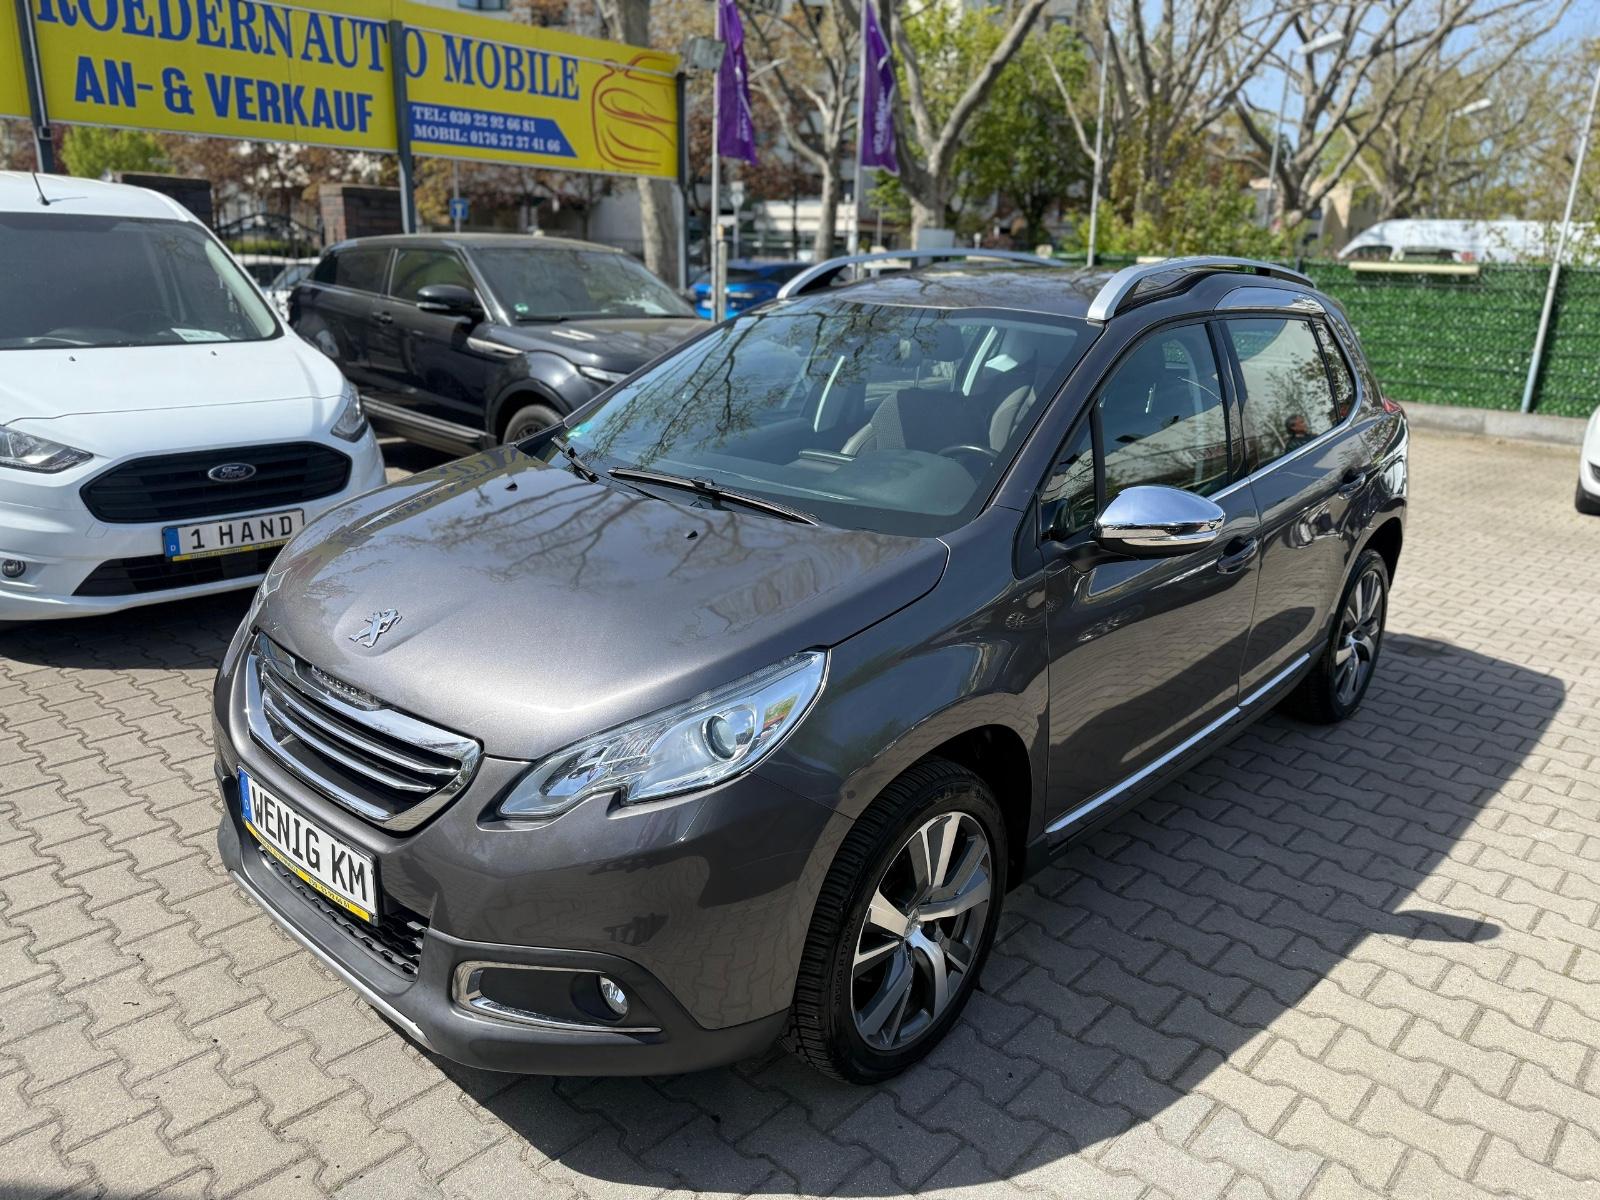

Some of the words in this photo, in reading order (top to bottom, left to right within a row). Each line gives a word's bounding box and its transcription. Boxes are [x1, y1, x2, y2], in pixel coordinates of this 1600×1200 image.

[442, 34, 580, 101] MOBILE
[75, 55, 153, 108] AN-
[162, 67, 195, 115] &
[204, 72, 374, 133] VERKAUF
[412, 106, 447, 123] TEL:
[449, 110, 472, 126] 030
[473, 113, 488, 128] 22
[490, 115, 504, 130] 92
[506, 117, 521, 131] 66
[522, 119, 536, 133] 81
[413, 124, 468, 143] MOBIL:
[470, 130, 498, 147] 0176
[499, 134, 513, 148] 37
[516, 136, 529, 150] 37
[532, 138, 545, 151] 41
[220, 466, 246, 479] Ford
[170, 544, 177, 552] D
[190, 528, 205, 550] 1
[219, 515, 293, 546] HAND
[252, 785, 321, 873] WENIG
[331, 844, 367, 902] KM
